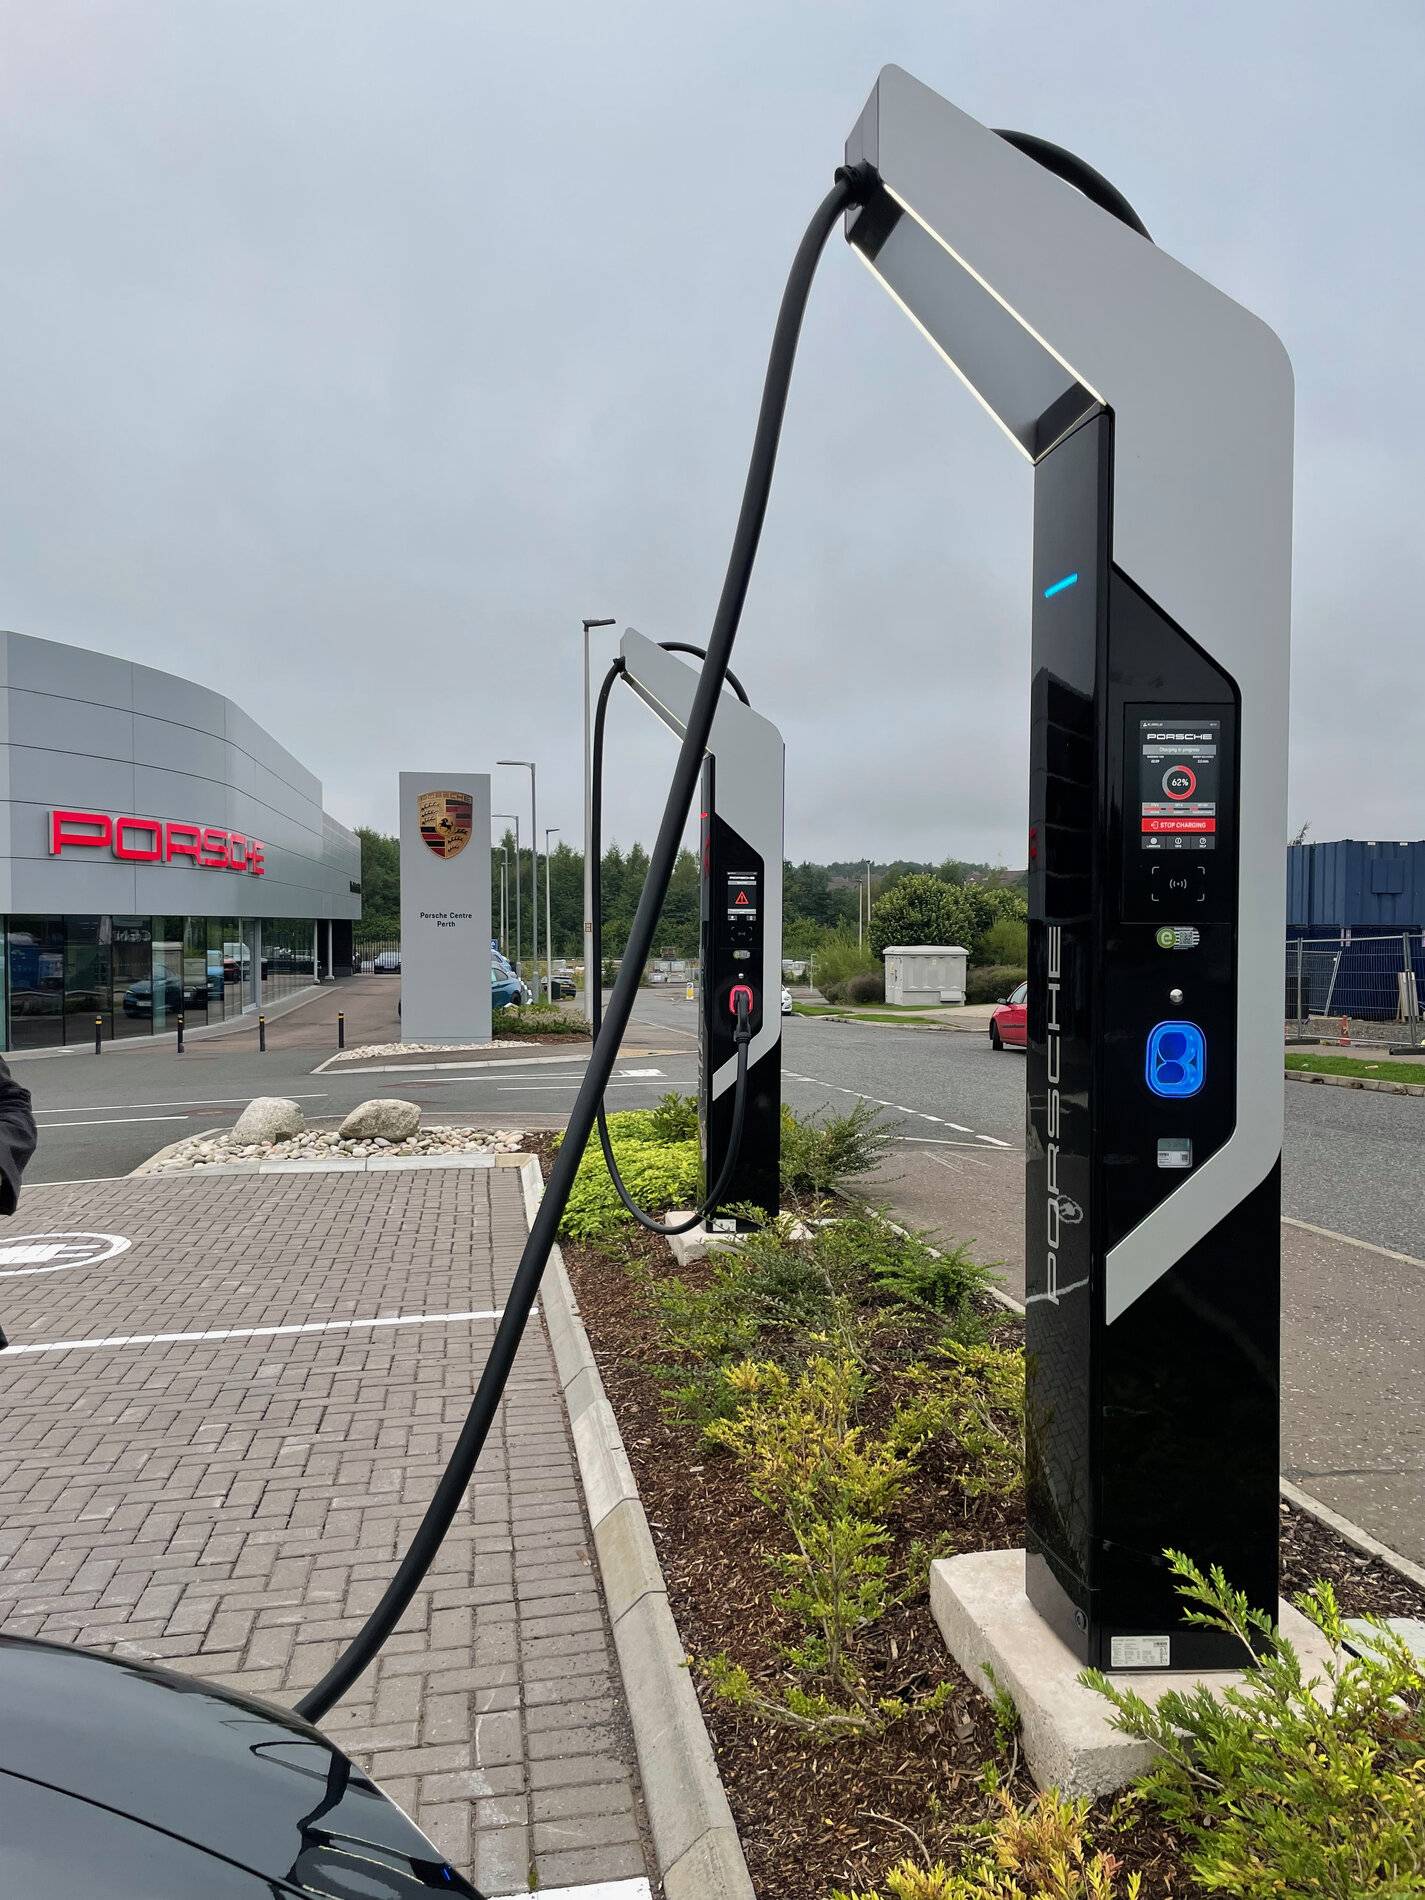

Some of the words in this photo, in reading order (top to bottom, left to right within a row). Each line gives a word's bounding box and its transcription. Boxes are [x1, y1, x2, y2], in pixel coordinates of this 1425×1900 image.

[48, 810, 265, 875] PORSCHE
[420, 911, 448, 919] Porsche
[1047, 926, 1062, 1306] PORSCHE
